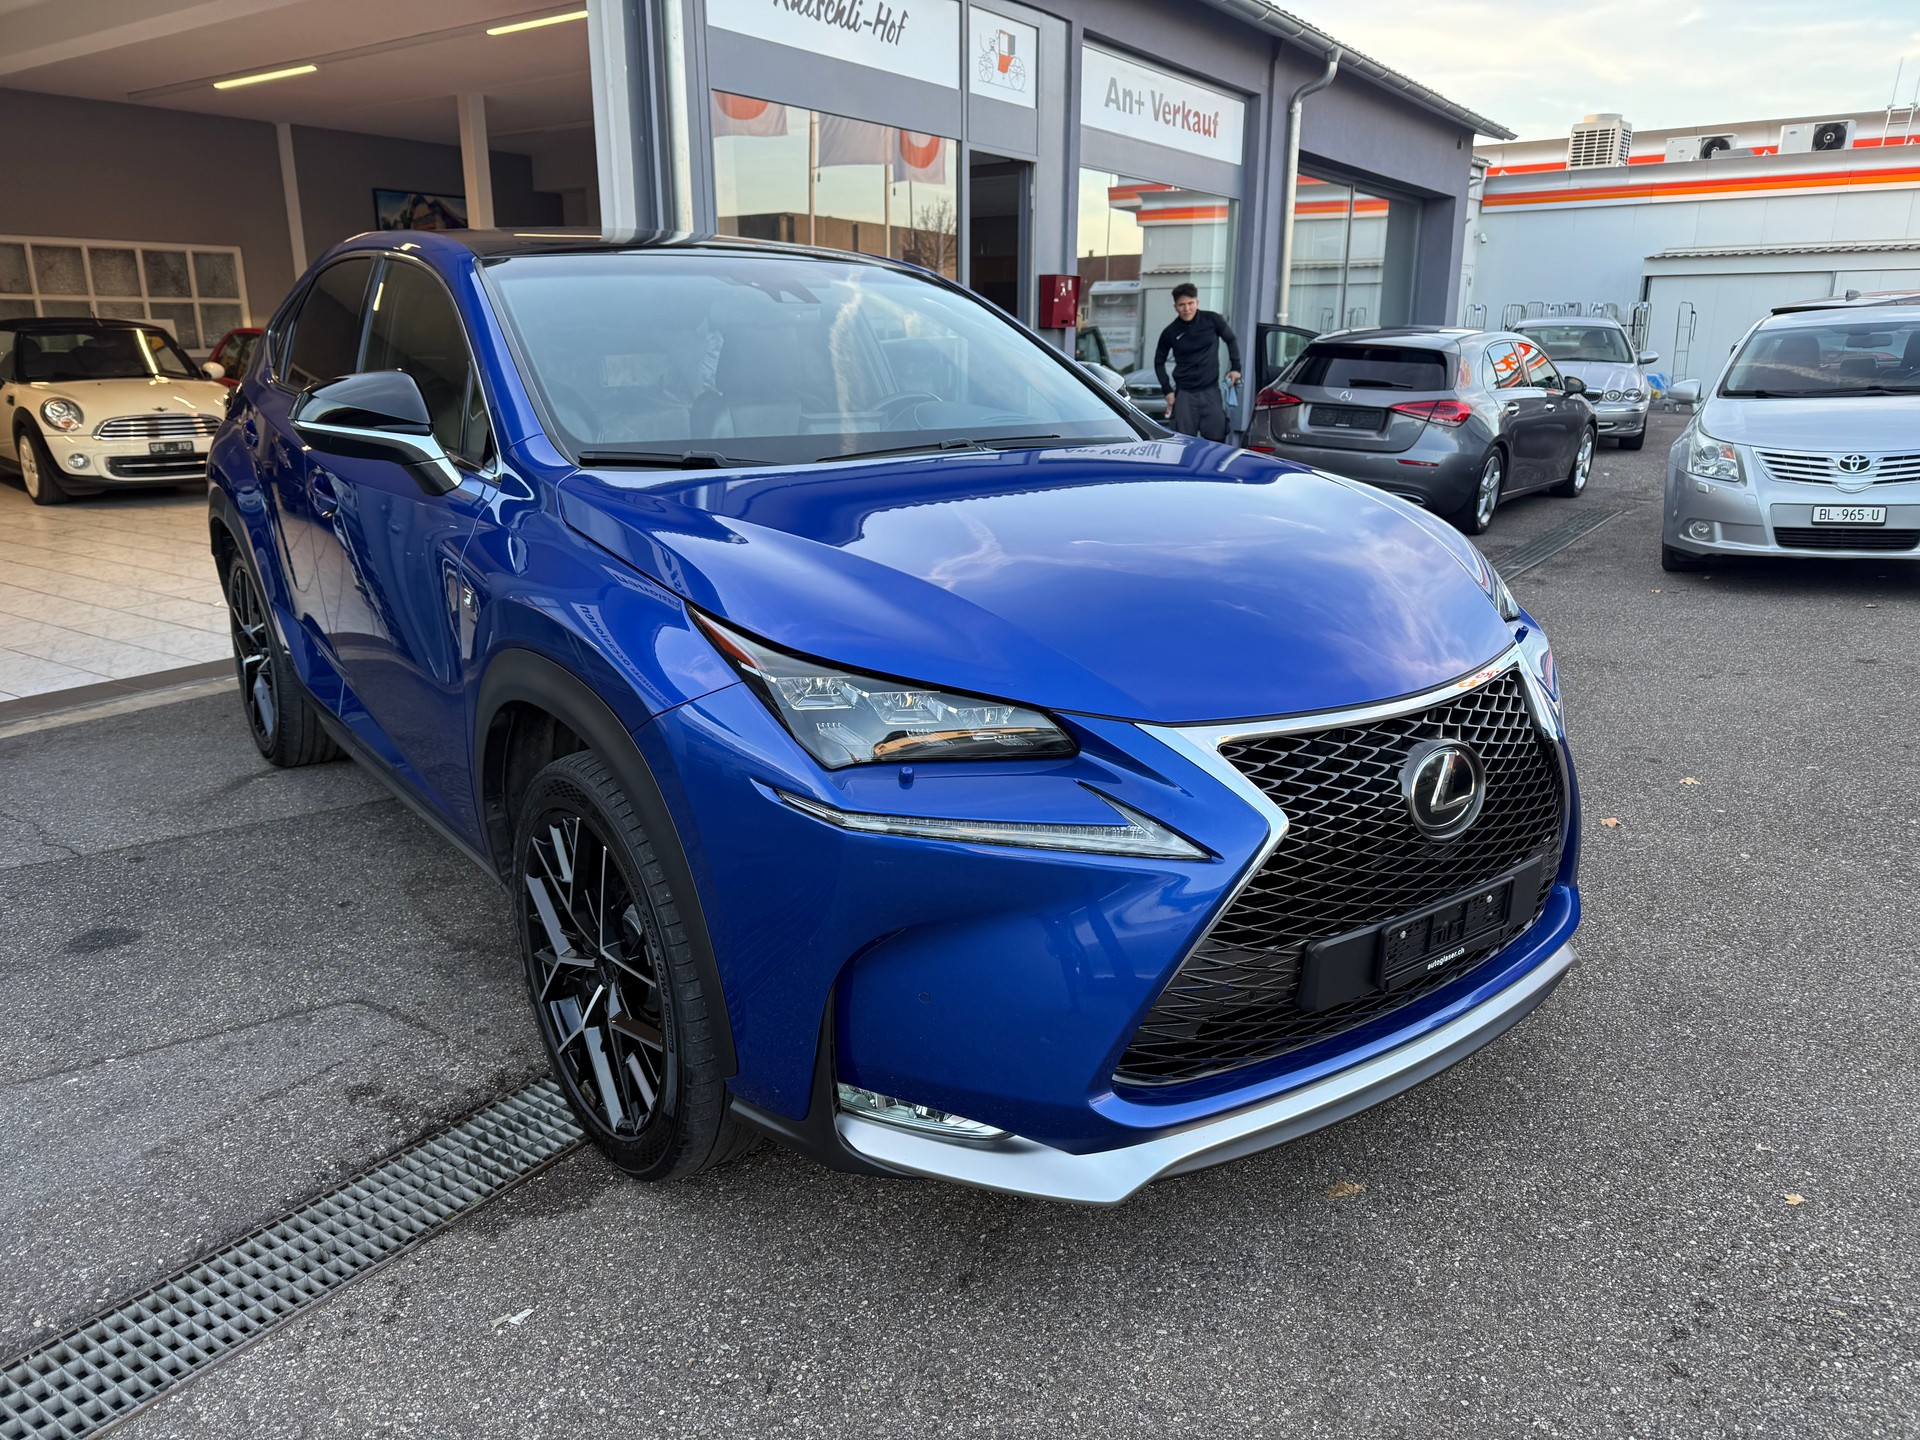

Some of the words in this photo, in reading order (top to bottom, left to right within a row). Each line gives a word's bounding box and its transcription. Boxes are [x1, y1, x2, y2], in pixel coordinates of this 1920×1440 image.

[1104, 77, 1145, 115] An+
[1150, 90, 1219, 138] Verkauf
[1426, 946, 1465, 970] autoglaser.ch
